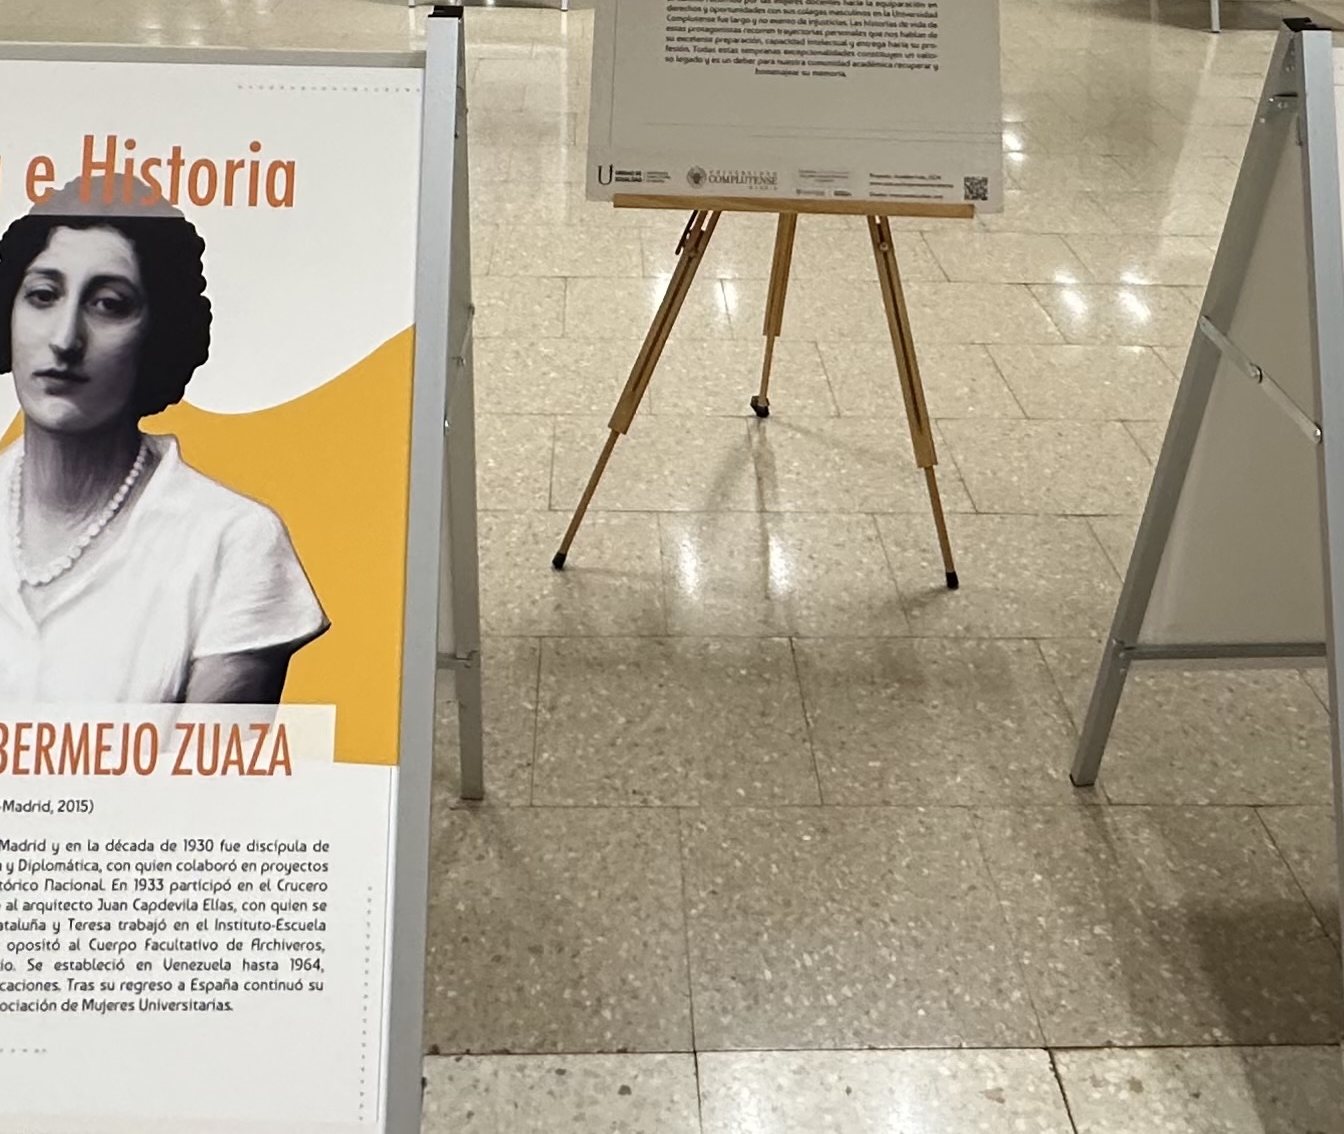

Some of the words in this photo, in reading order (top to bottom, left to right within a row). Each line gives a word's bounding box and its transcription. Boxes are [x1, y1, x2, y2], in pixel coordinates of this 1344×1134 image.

[26, 156, 54, 204] e
[80, 135, 294, 207] Historia
[171, 723, 292, 776] ZUAZA
[56, 798, 94, 815] 2015)
[50, 842, 60, 856] y
[64, 841, 82, 852] en
[86, 838, 100, 852] la
[104, 838, 155, 852] década
[159, 838, 178, 853] de
[182, 838, 214, 853] 1930
[219, 838, 241, 853] fue
[245, 838, 307, 856] discípula
[311, 838, 330, 853] de
[5, 937, 61, 955] opositó
[67, 936, 81, 952] al
[88, 937, 137, 955] Cuerpo
[143, 937, 219, 952] Facultativo
[225, 936, 244, 952] de
[250, 936, 326, 954] Archiveros,
[59, 997, 79, 1012] de
[81, 997, 135, 1016] Mujeres
